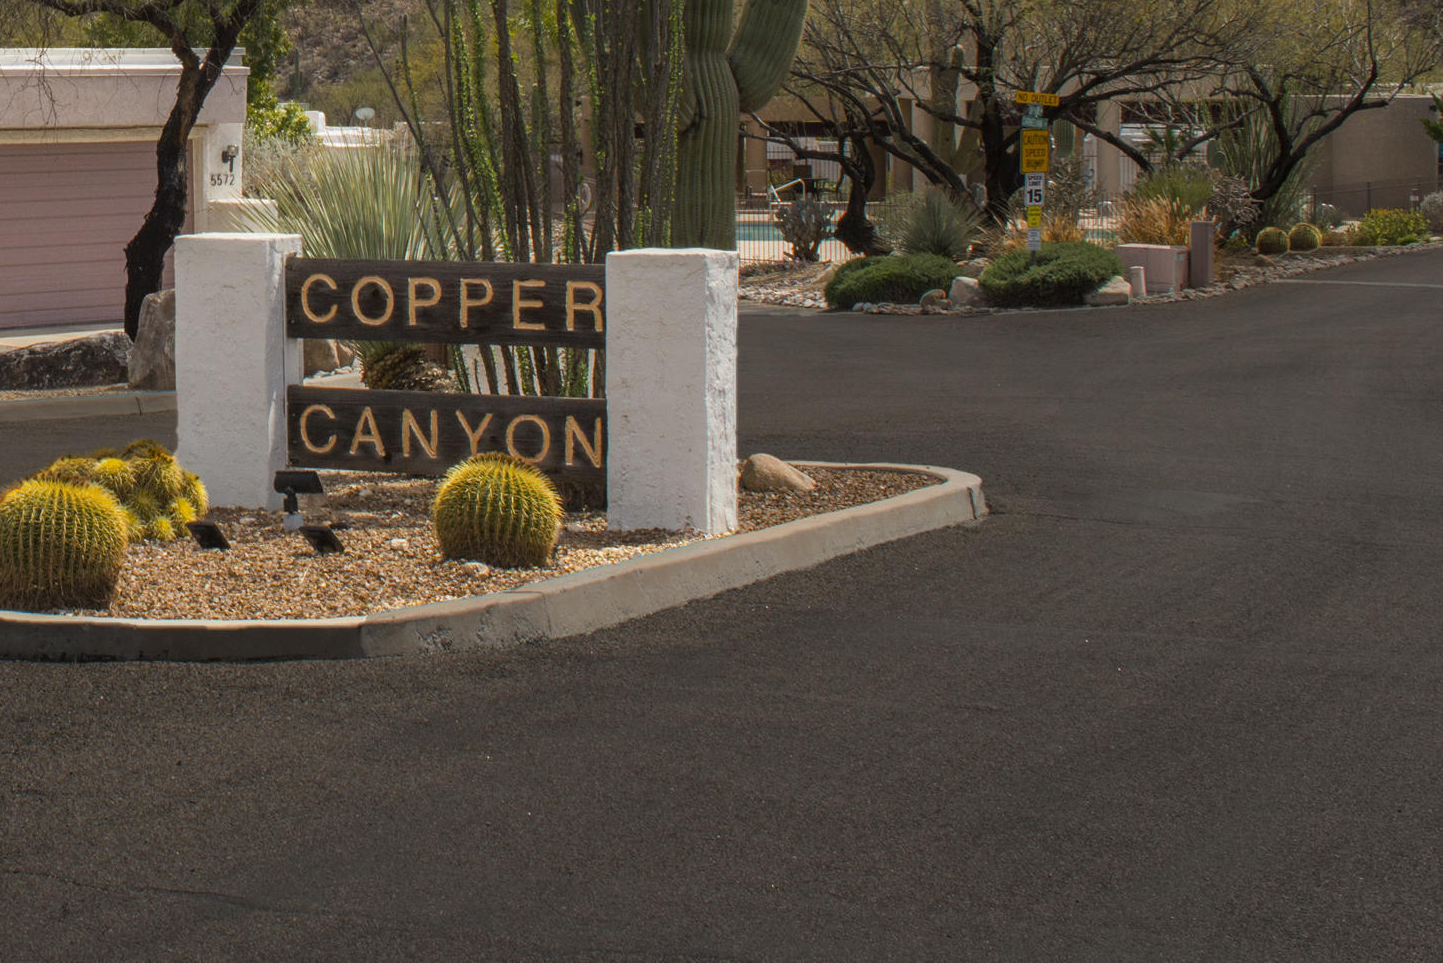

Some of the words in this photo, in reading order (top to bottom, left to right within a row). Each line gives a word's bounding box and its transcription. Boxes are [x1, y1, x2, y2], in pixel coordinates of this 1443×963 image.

[1031, 94, 1057, 105] OUTLET
[1026, 148, 1046, 157] SPEED
[1026, 158, 1045, 168] BUMP
[210, 173, 235, 187] 5572
[1027, 188, 1042, 203] 15
[301, 274, 604, 332] COPPER
[300, 404, 603, 468] CANYON
